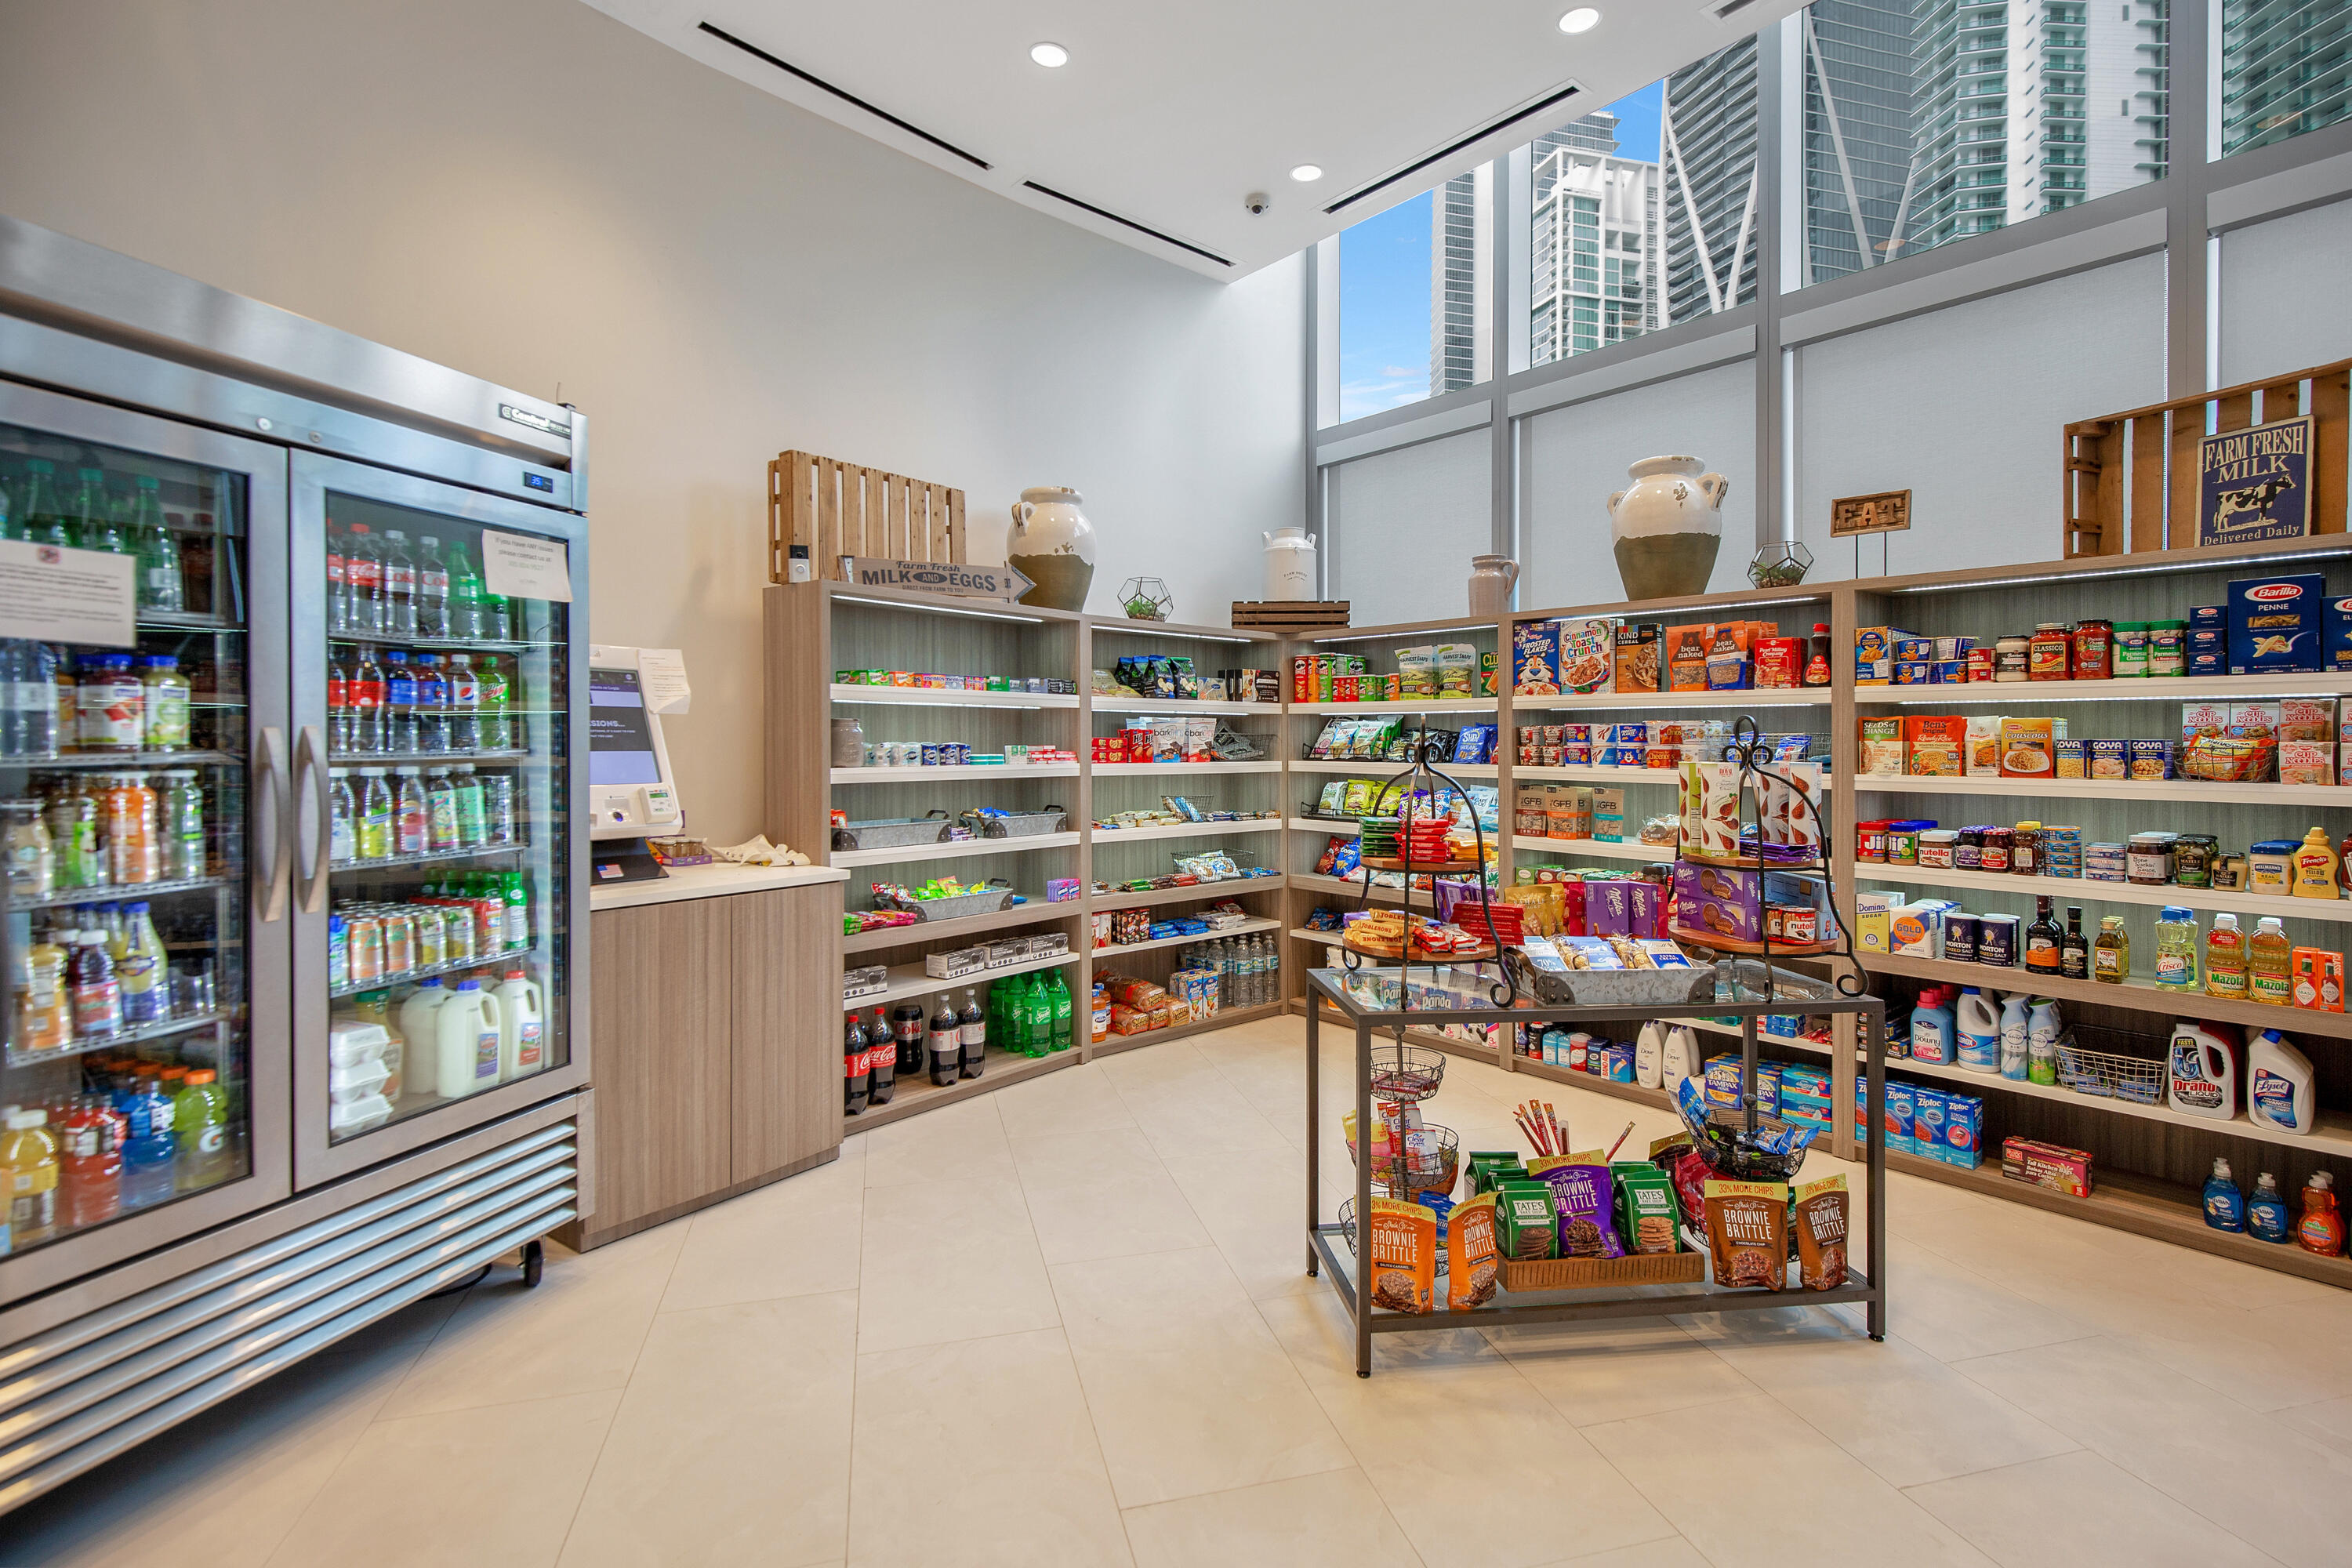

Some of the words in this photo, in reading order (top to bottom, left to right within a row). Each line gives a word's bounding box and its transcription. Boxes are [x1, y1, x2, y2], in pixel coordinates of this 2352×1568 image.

[2205, 436, 2249, 473] FARM
[2251, 425, 2305, 456] FRESH
[2213, 456, 2290, 483] MILK
[1838, 499, 1903, 528] EAT
[2205, 530, 2261, 545] Delivered
[2267, 525, 2299, 538] Daily
[897, 561, 926, 570] Farm
[930, 563, 960, 572] Fresh
[862, 570, 911, 584] MILK
[923, 573, 939, 582] AND
[949, 573, 996, 592] EGGS
[2257, 587, 2298, 597] Barilla
[1565, 628, 1602, 641] Cinnamon
[1523, 639, 1550, 649] FROSTED
[1571, 637, 1595, 648] Toast
[1524, 645, 1548, 655] FLAKES
[1568, 644, 1602, 658] Crunch
[1677, 867, 1693, 877] Milka
[1611, 887, 1624, 916] Milka
[1636, 888, 1645, 917] Milka
[1679, 902, 1696, 910] Milka
[1859, 903, 1885, 912] Domino
[1362, 923, 1392, 934] TOBLERONE
[1896, 924, 1921, 934] GOLD
[1980, 945, 2005, 953] MORTON
[2158, 960, 2183, 973] Crisco
[2211, 974, 2244, 985] Mazola
[2255, 978, 2289, 992] Mazola
[1422, 996, 1450, 1010] panda
[895, 1022, 923, 1035] Coke
[1915, 1034, 1941, 1047] Downy
[1707, 1079, 1737, 1089] TAMPAX
[2173, 1080, 2216, 1091] Drano
[2258, 1080, 2286, 1091] Lysol
[1887, 1091, 1911, 1100] Ziploc
[1917, 1098, 1942, 1107] Ziploc
[1949, 1102, 1969, 1111] Ziploc
[1539, 1159, 1552, 1168] 33%
[1553, 1156, 1572, 1167] MORE
[1573, 1153, 1592, 1163] CHIPS
[2038, 1162, 2058, 1171] Kitchen
[1551, 1180, 1595, 1197] BROWNIE
[1719, 1184, 1732, 1194] 33%
[1733, 1185, 1750, 1193] MORE
[1755, 1185, 1774, 1196] CHIPS
[1806, 1186, 1814, 1196] 33%
[1814, 1184, 1826, 1192] MORE
[1827, 1178, 1839, 1190] CHIPS
[1637, 1191, 1664, 1200] TATE'S
[1381, 1201, 1401, 1210] MORE
[1402, 1204, 1422, 1215] CHIPS
[1515, 1201, 1544, 1211] TATE'S
[1555, 1194, 1598, 1211] BRITTLE
[1723, 1209, 1770, 1225] BROWNIE
[1809, 1206, 1842, 1225] BROWNIE
[1464, 1221, 1492, 1240] BROWNIE
[1726, 1224, 1773, 1240] BRITTLE
[1812, 1220, 1845, 1240] BRITTLE
[1373, 1229, 1417, 1248] BROWNIE
[1373, 1245, 1417, 1263] BRITTLE
[1465, 1237, 1496, 1259] BRITTLE
